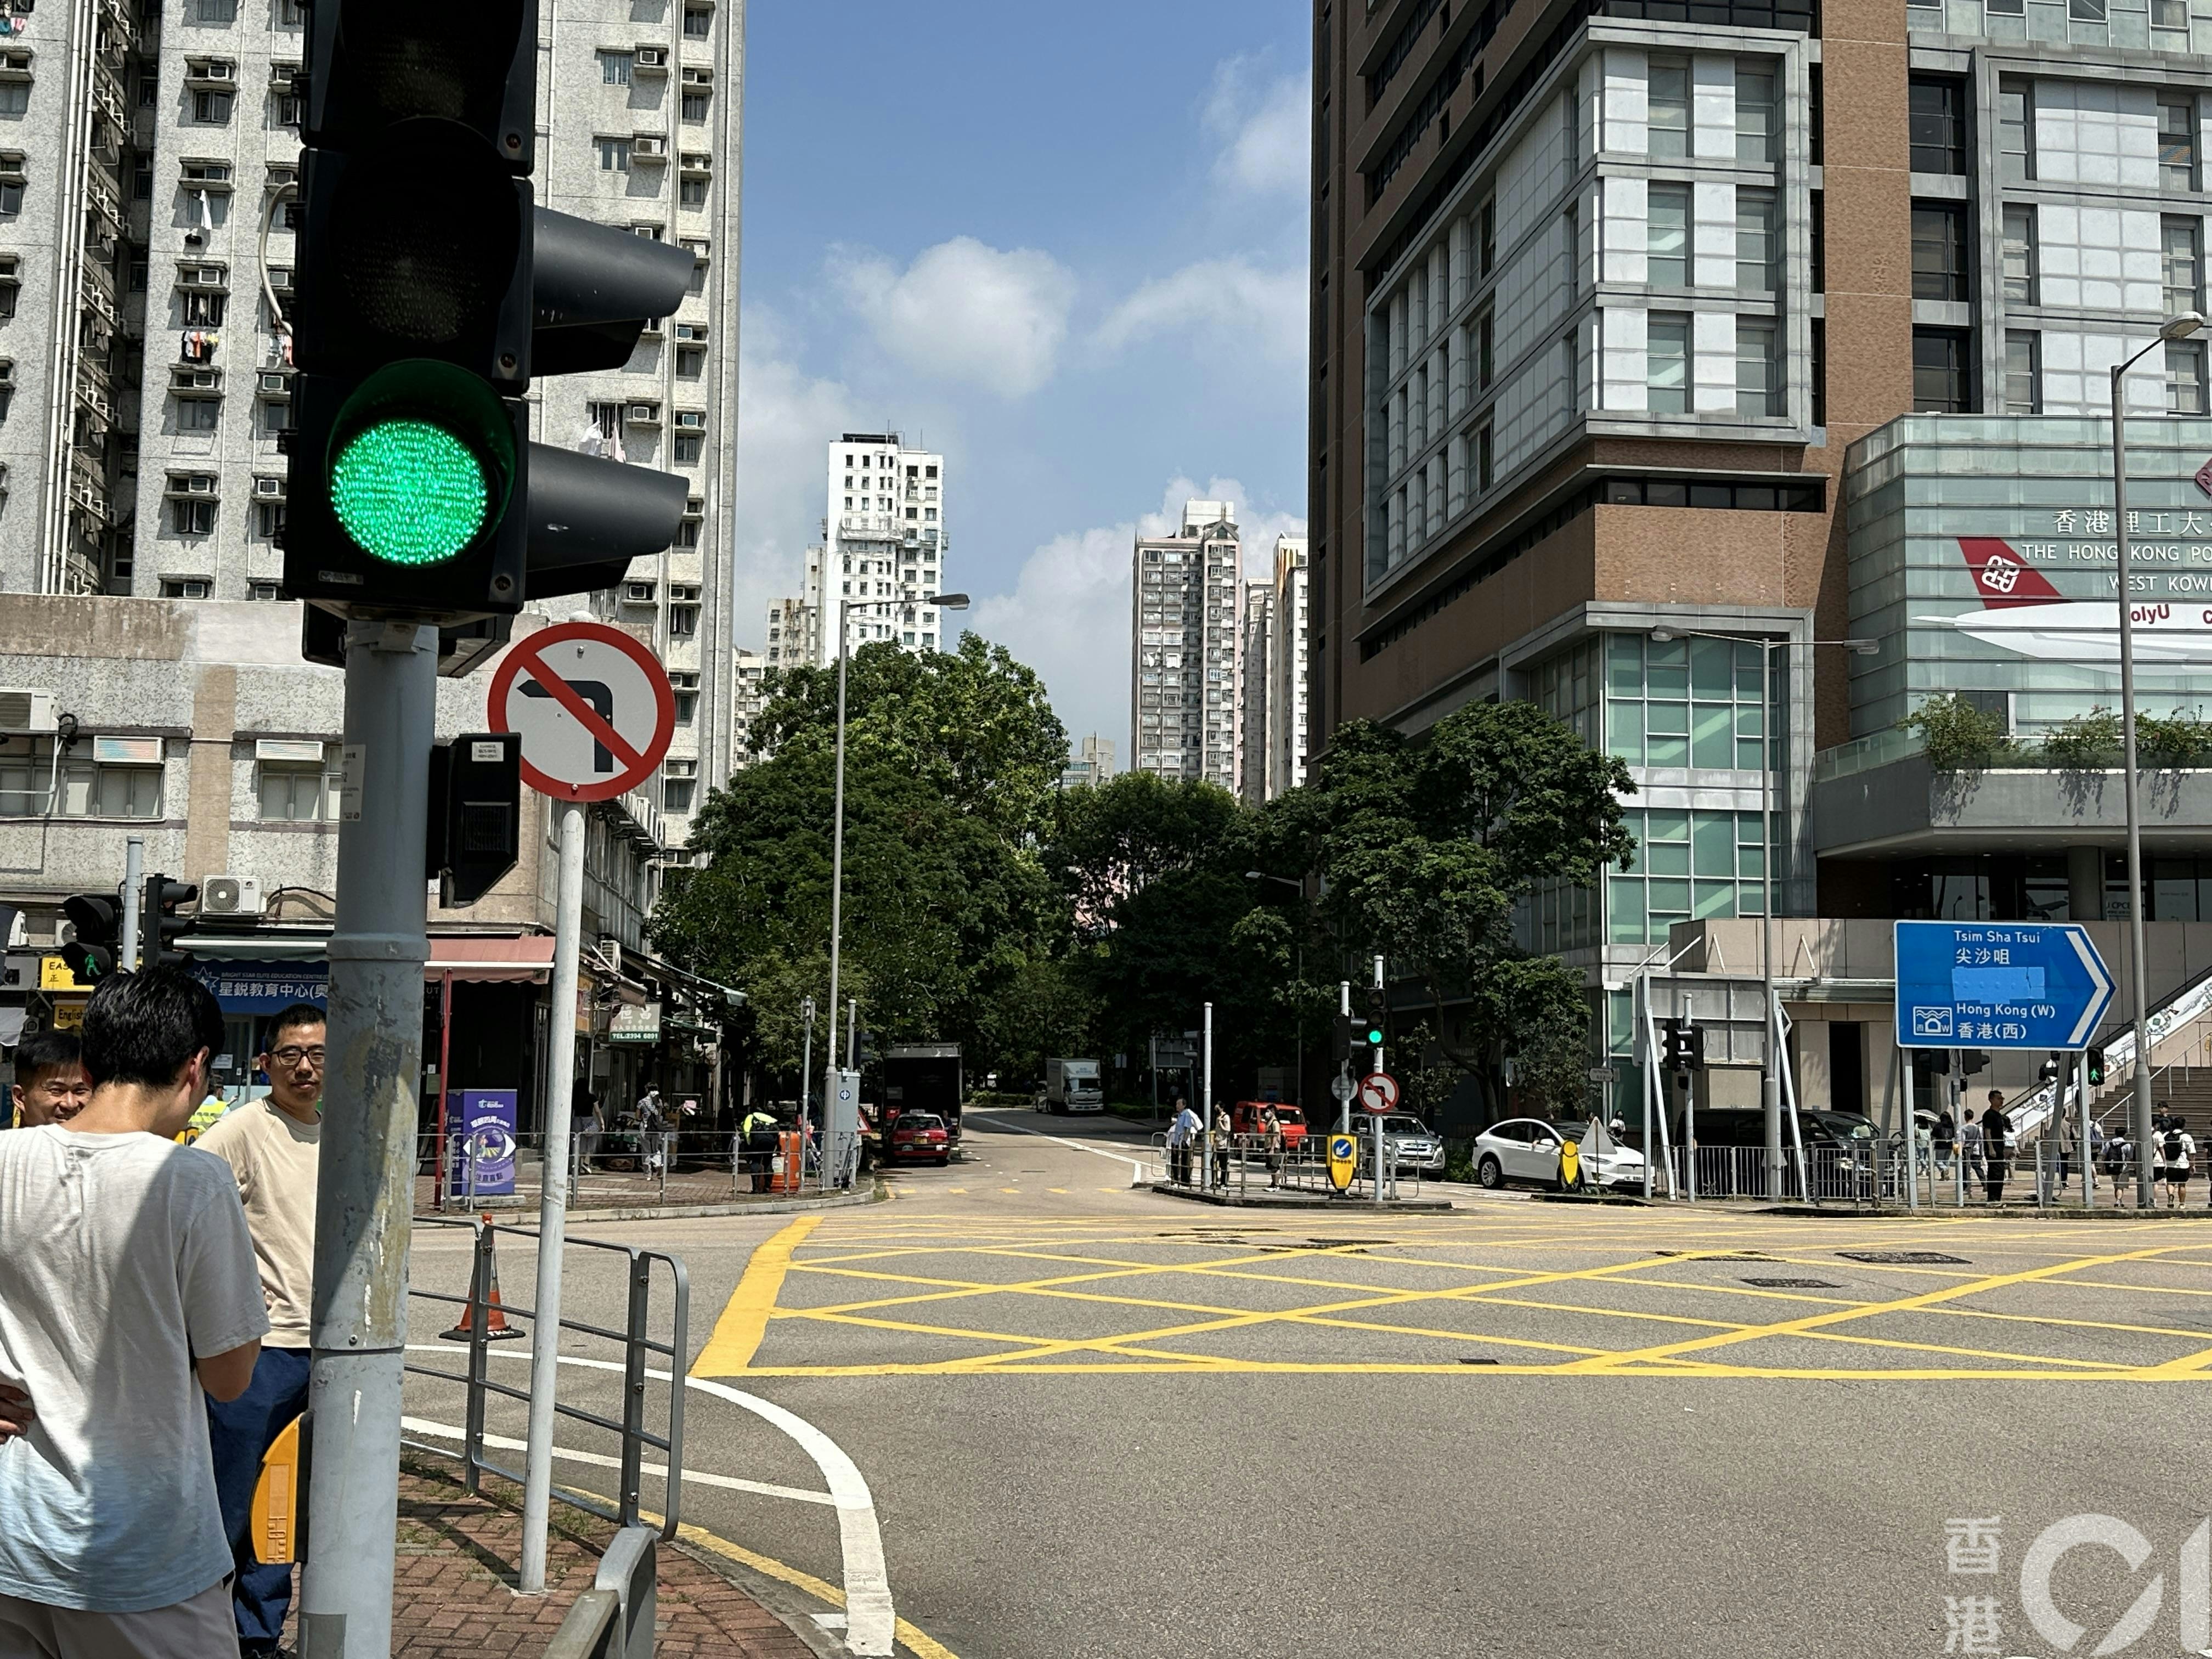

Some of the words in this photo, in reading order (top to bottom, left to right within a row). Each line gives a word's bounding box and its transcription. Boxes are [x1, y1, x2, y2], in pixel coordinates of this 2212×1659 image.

[2052, 509, 2212, 535] 香港理工大
[2022, 544, 2057, 560] THE
[2069, 544, 2118, 561] HONG
[2131, 545, 2180, 561] KONG
[2108, 575, 2158, 591] WEST
[2130, 603, 2170, 624] olyU
[1954, 930, 1983, 942] Tsim
[1987, 930, 2011, 943] Sha
[2015, 932, 2040, 944] Tsui
[1955, 947, 2011, 965] 尖沙咀
[58, 1009, 83, 1021] English
[1956, 1002, 1990, 1018] Hong
[1995, 1003, 2027, 1018] Kong
[2031, 1005, 2056, 1019] (W)
[1941, 1024, 1950, 1032] W
[1957, 1022, 2027, 1040] 香港(西)
